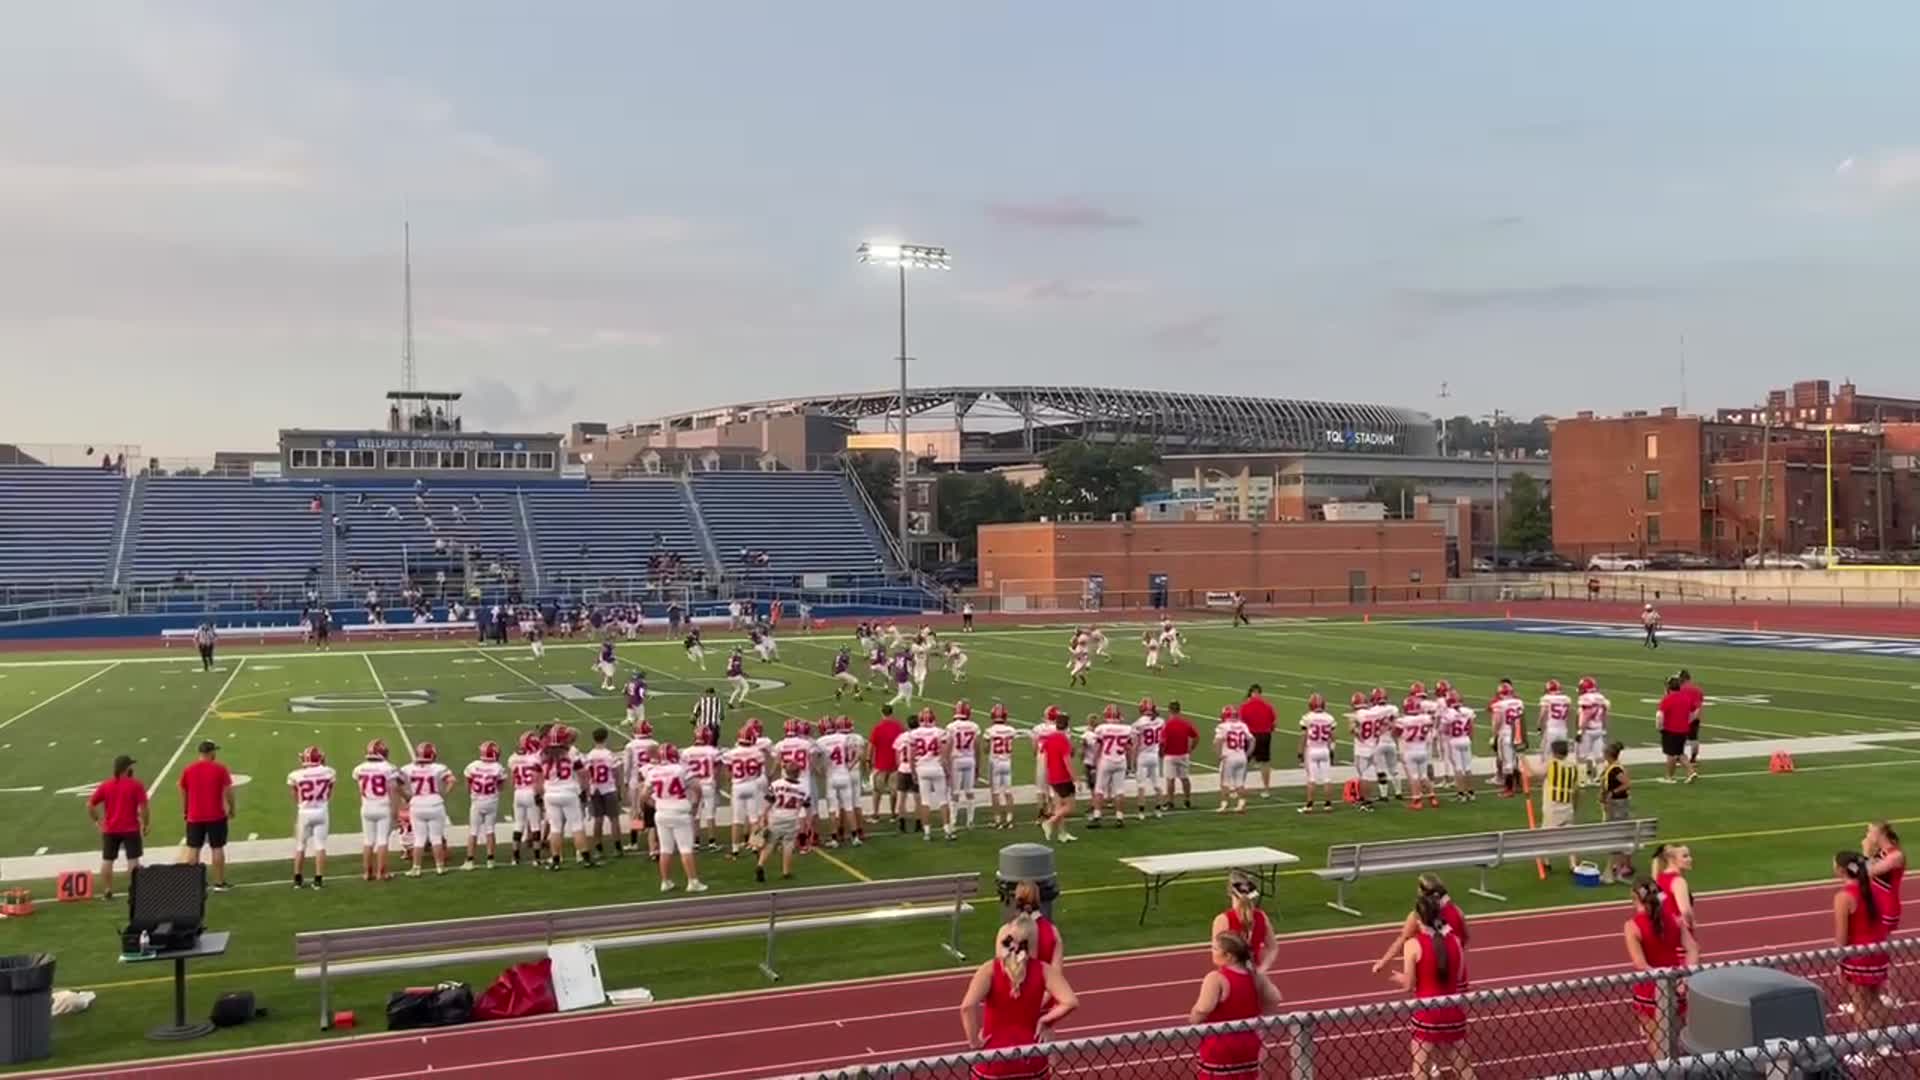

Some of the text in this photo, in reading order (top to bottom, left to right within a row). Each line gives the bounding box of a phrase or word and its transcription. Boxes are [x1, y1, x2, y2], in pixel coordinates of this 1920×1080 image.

[1354, 432, 1395, 445] STADIUM
[956, 731, 976, 750] 17
[1309, 723, 1331, 741] 35
[299, 779, 330, 801] 27
[358, 775, 387, 798] 78
[410, 775, 438, 796] 71
[62, 873, 88, 897] 40
